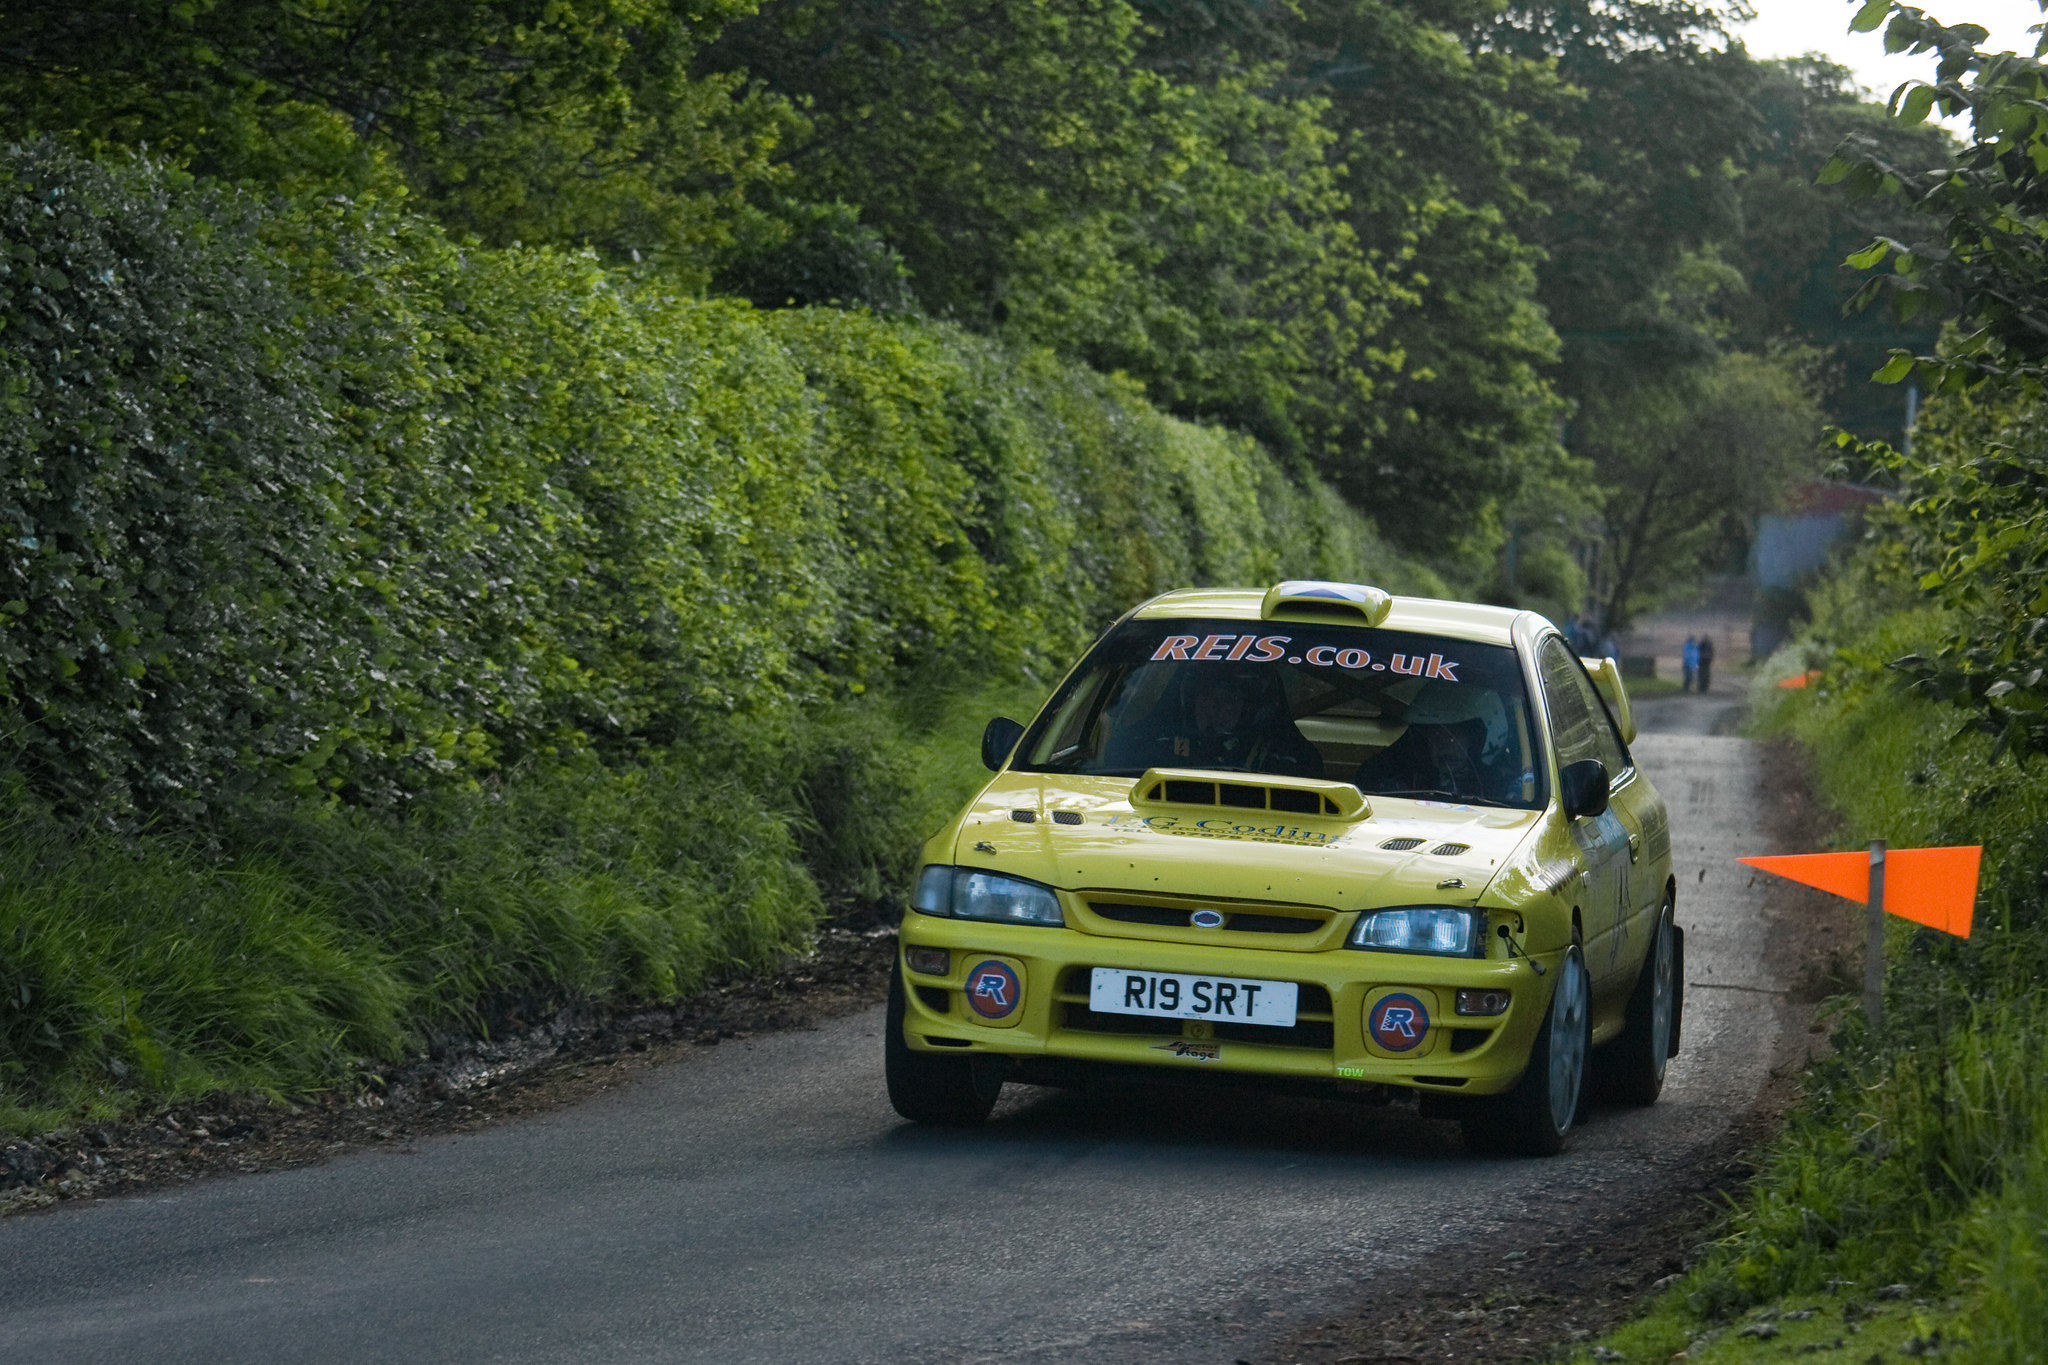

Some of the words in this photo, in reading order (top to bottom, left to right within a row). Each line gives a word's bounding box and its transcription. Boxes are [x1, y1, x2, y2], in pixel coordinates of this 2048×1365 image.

[1150, 634, 1460, 682] REIS.co.uk
[975, 973, 1008, 1005] R
[1124, 975, 1180, 1011] R19
[1192, 980, 1262, 1017] SRT
[1380, 1007, 1416, 1037] R
[1336, 1067, 1365, 1077] TOW
